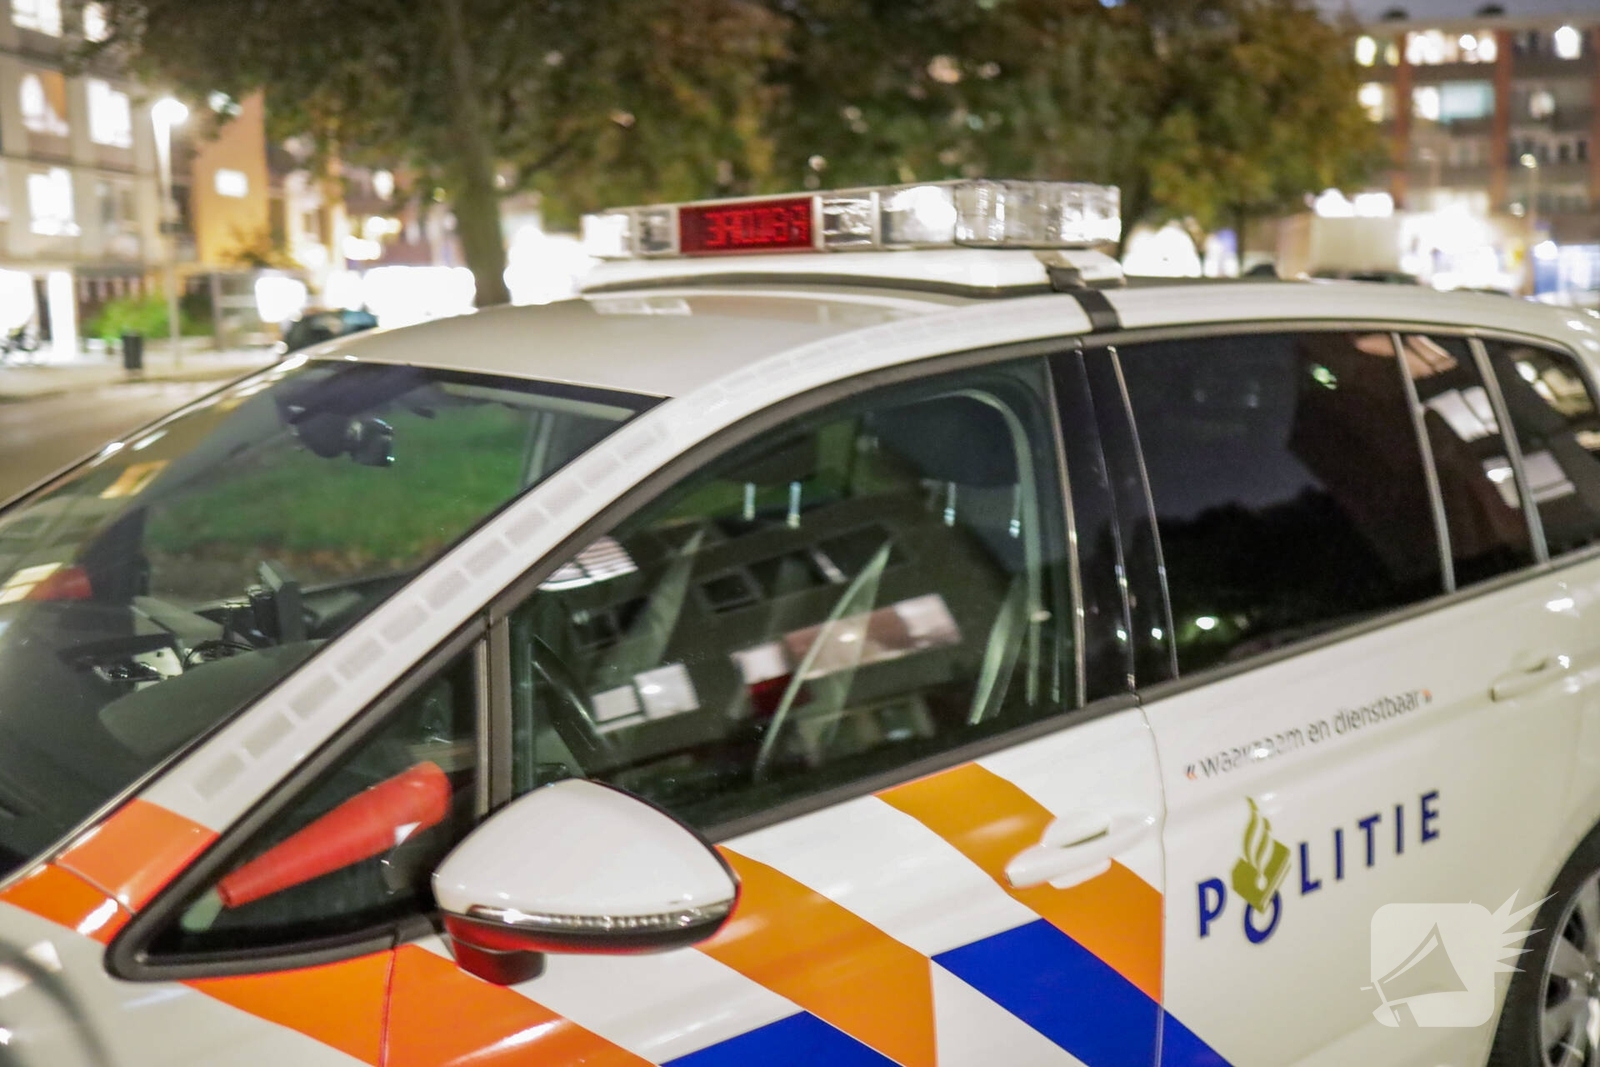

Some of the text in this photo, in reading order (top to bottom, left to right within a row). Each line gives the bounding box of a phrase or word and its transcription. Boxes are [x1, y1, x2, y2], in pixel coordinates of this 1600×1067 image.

[1308, 721, 1331, 744] en
[1333, 690, 1419, 735] dienstbaar
[1197, 790, 1440, 945] POLITIE
